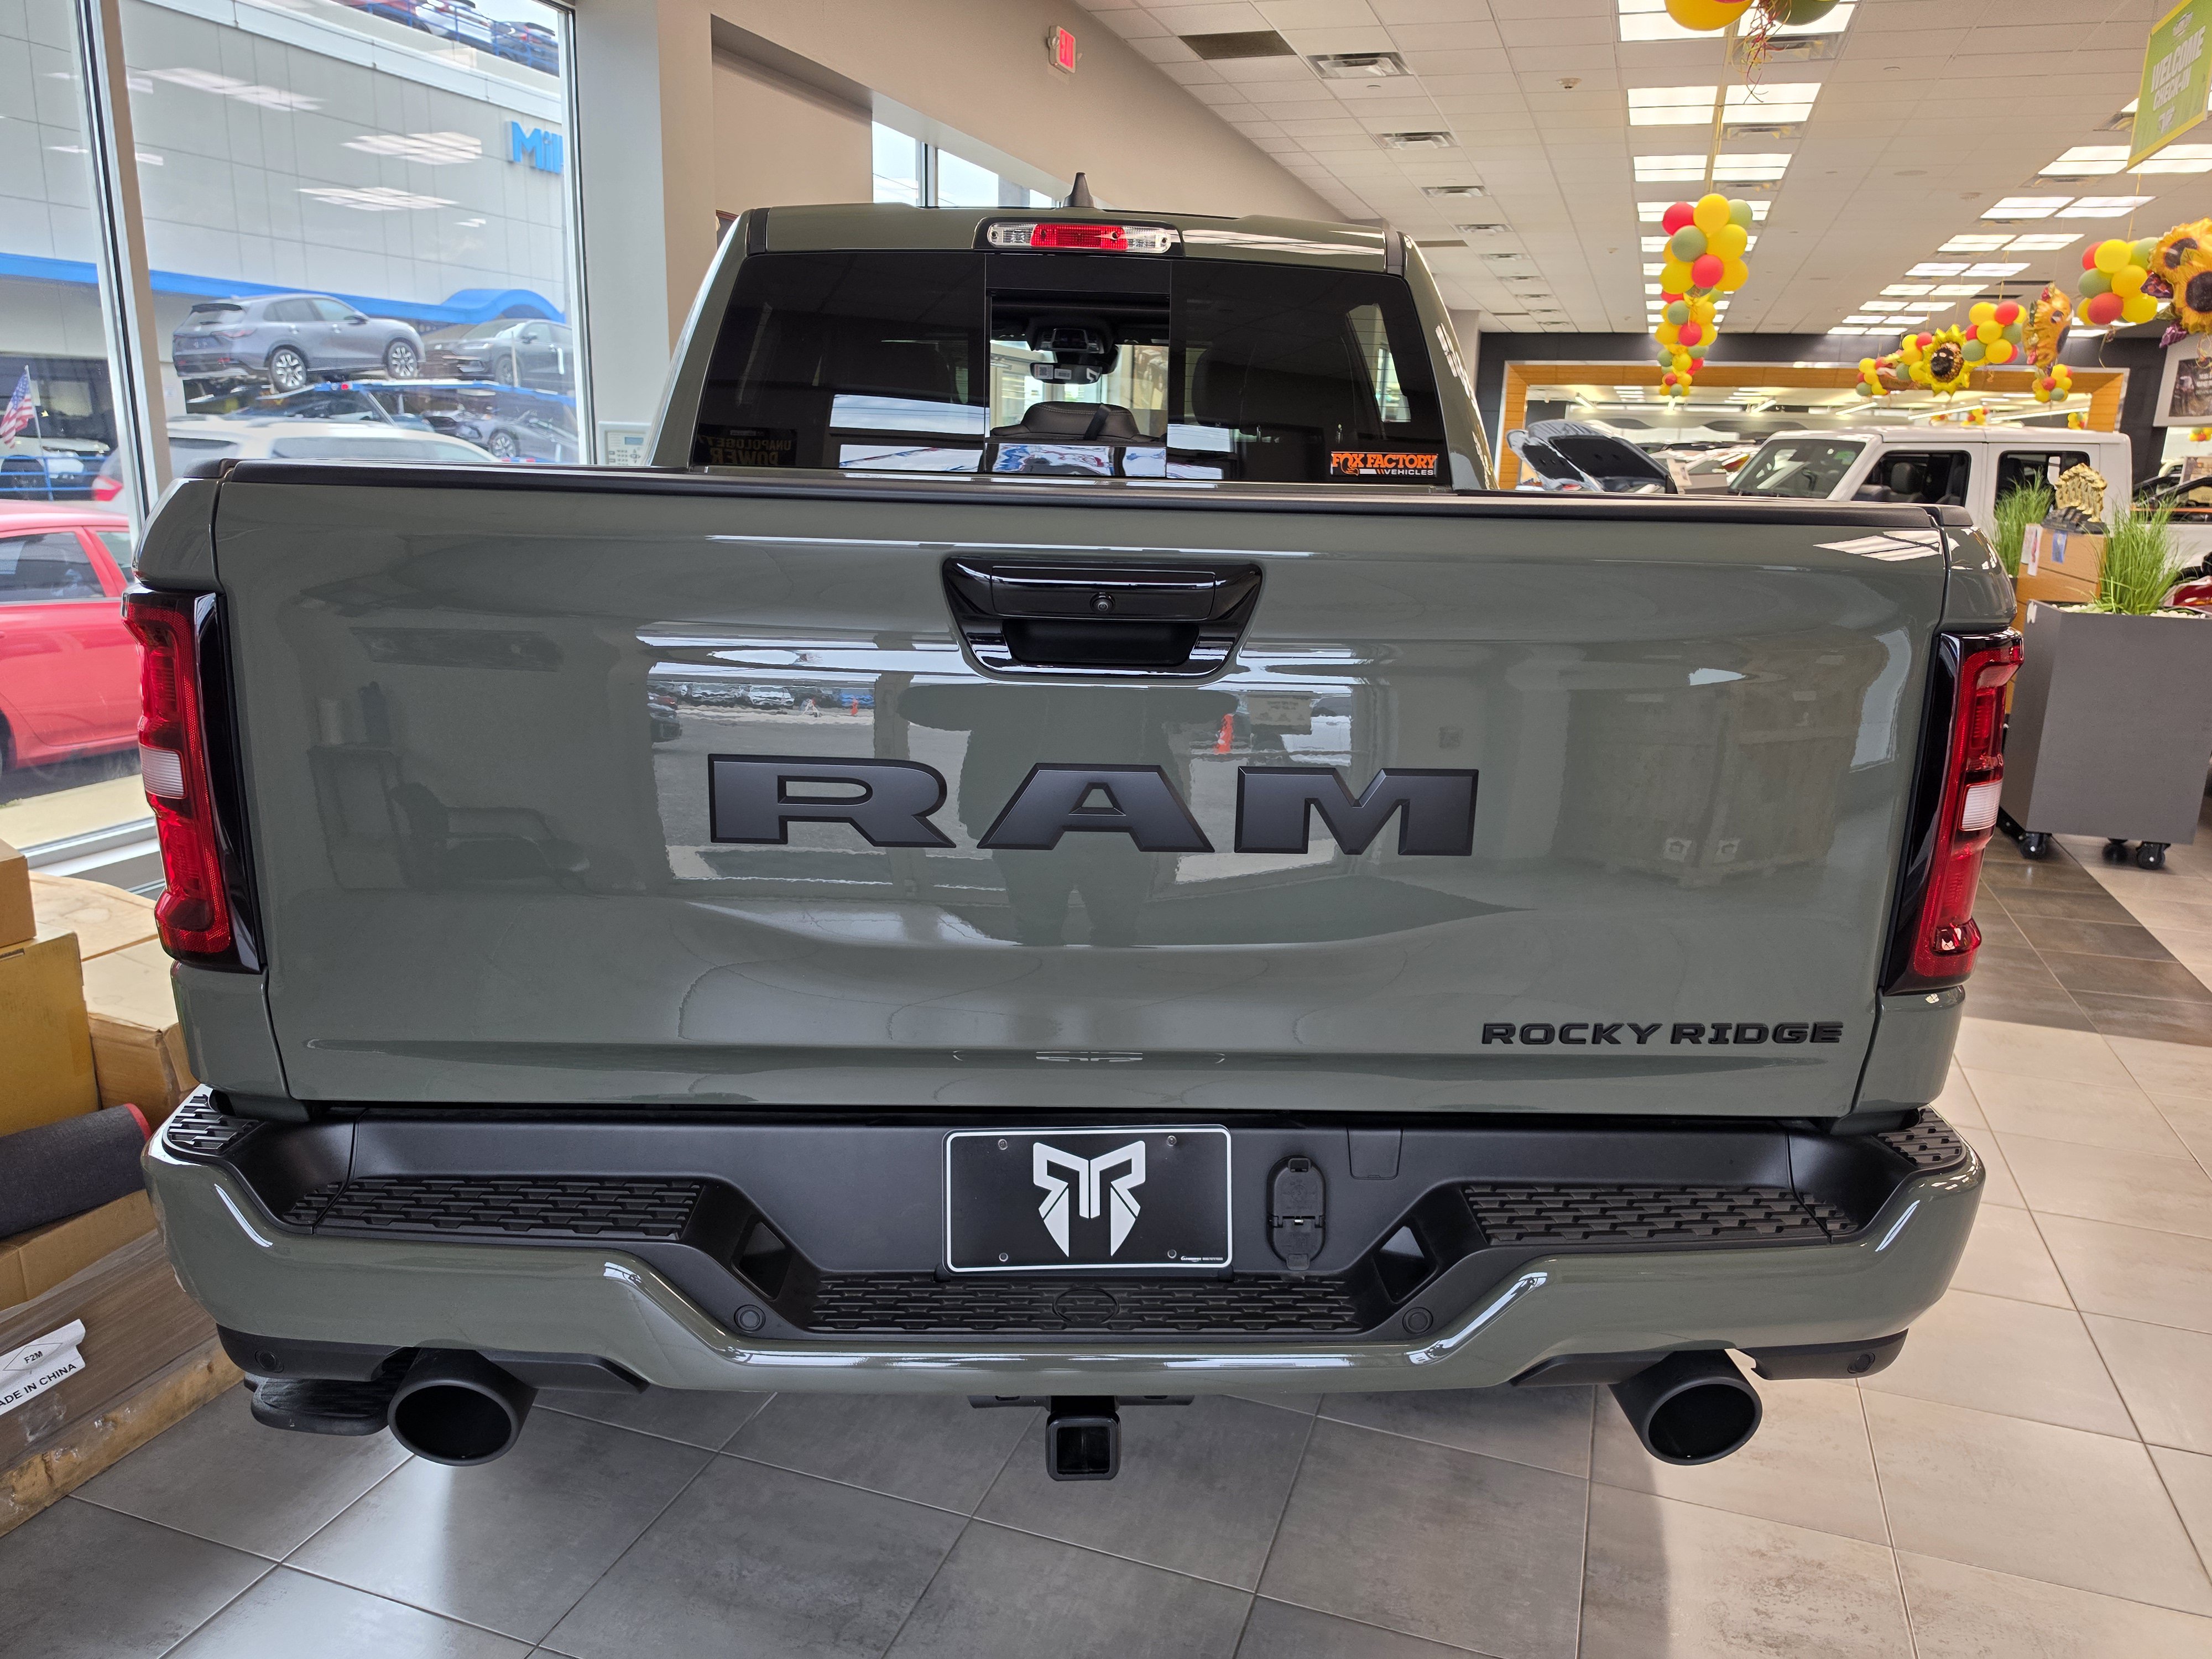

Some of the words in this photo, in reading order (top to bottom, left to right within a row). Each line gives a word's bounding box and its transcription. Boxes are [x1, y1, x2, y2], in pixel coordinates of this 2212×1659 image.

[2151, 25, 2205, 93] WELCOME
[2153, 65, 2192, 111] CHECK-IN
[1331, 453, 1364, 470] FOX
[1366, 454, 1437, 469] FACTORY
[708, 753, 1480, 857] RAM
[1481, 1022, 1663, 1045] ROCKY
[1670, 1021, 1844, 1045] RIDGE
[24, 1350, 43, 1364] F2M
[0, 1390, 23, 1406] ADE
[24, 1383, 37, 1394] IN
[39, 1364, 77, 1386] CHINA
